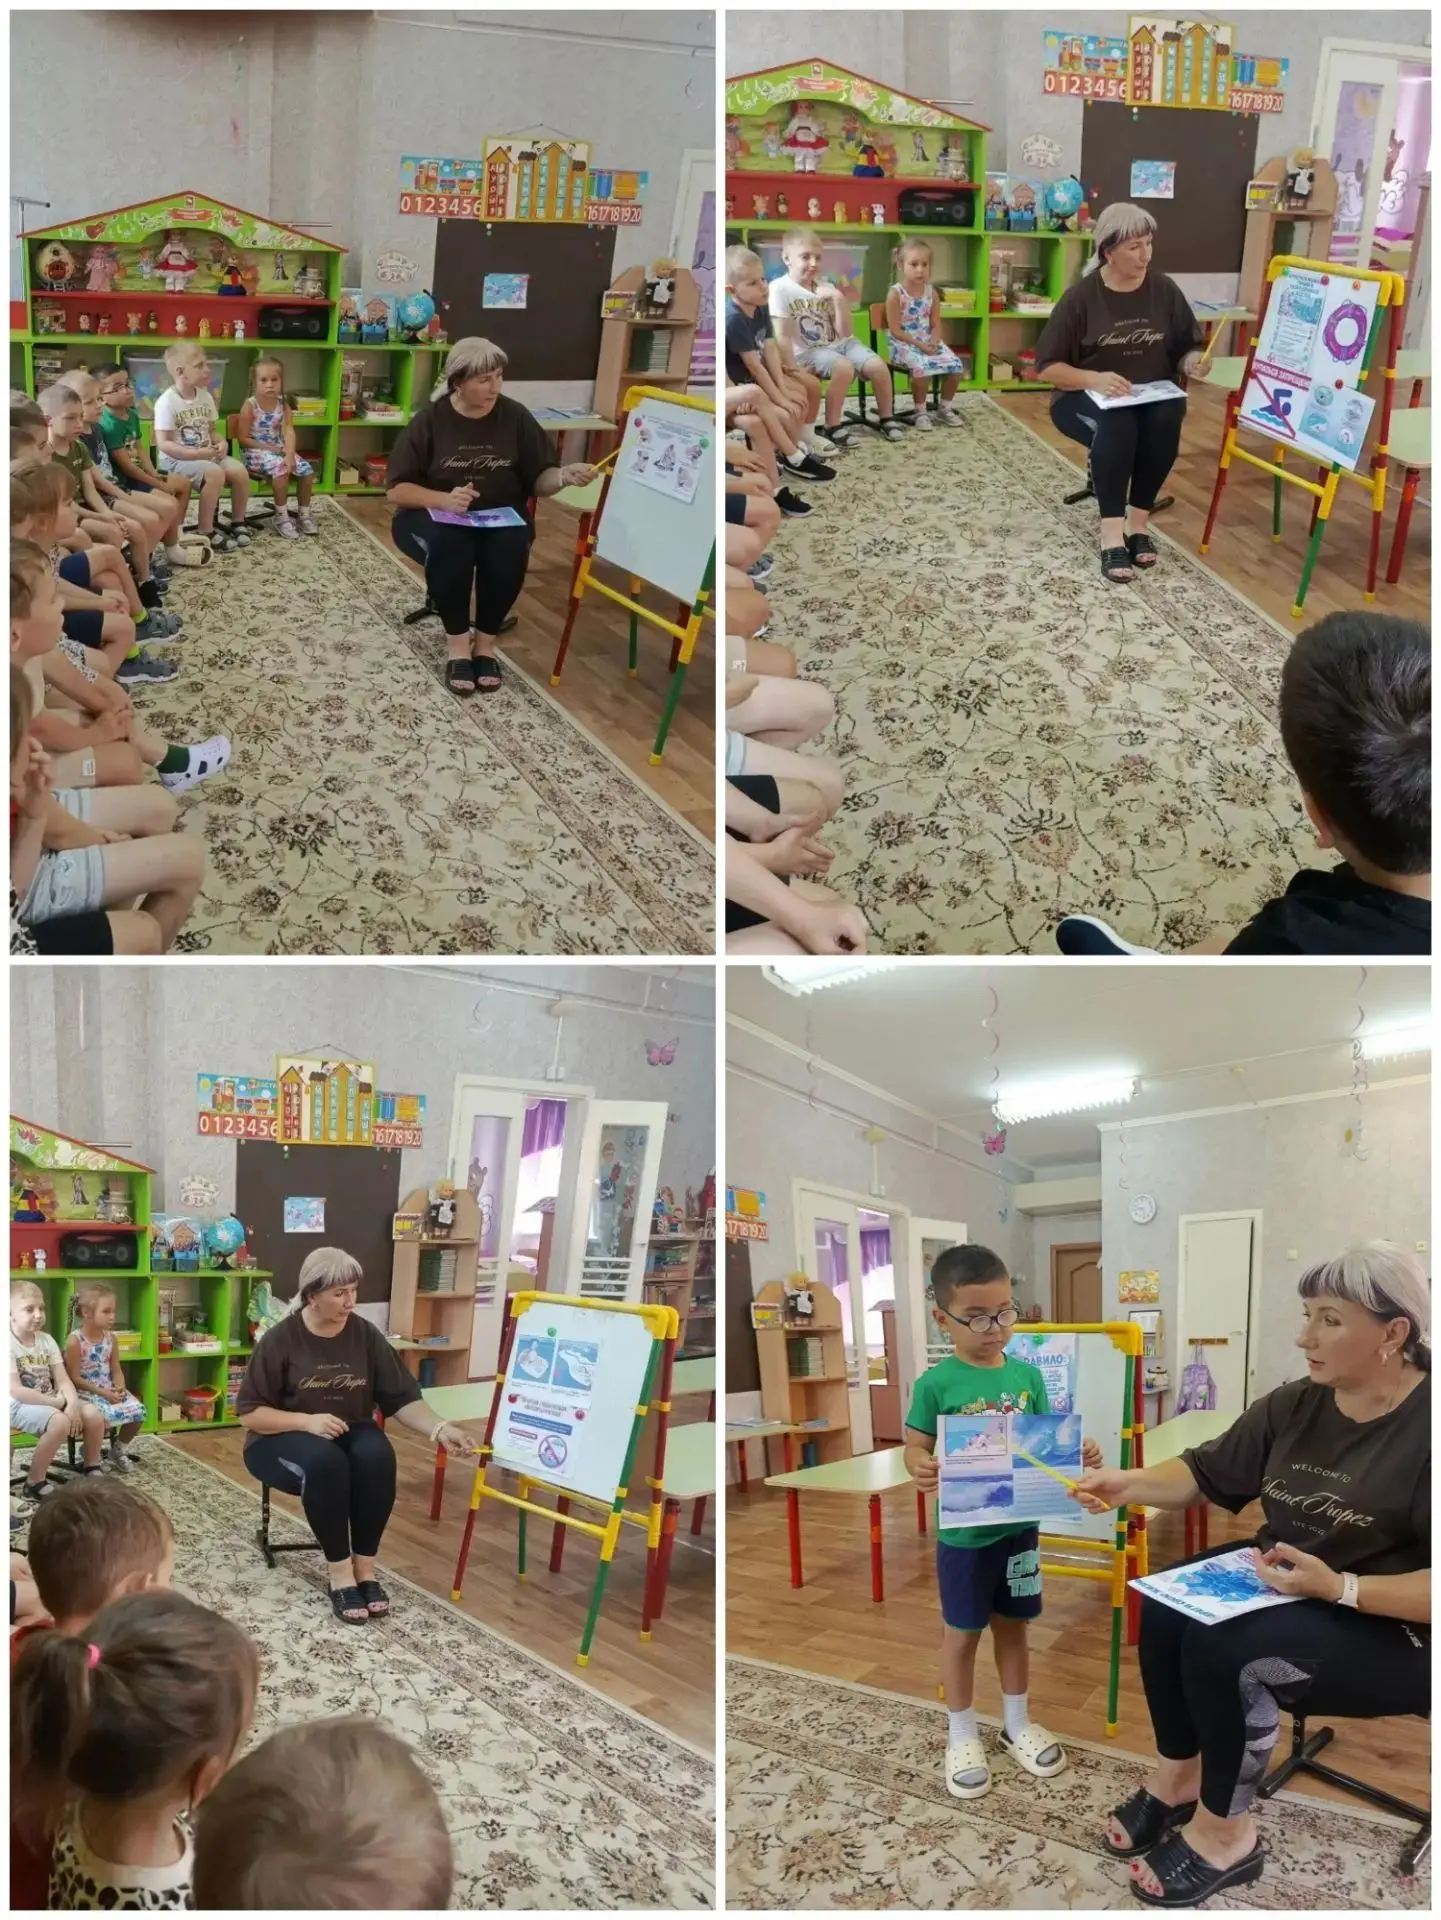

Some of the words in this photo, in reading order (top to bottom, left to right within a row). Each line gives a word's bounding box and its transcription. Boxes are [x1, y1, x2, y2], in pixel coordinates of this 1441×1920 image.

[1097, 331, 1131, 346] Saint
[440, 455, 472, 469] Saint
[472, 455, 512, 471] Tropez
[298, 1375, 332, 1389] Saint
[1291, 1463, 1340, 1479] WELCOME
[1340, 1474, 1351, 1483] TO
[1262, 1476, 1307, 1506] Saint
[1301, 1492, 1376, 1527] Tropez
